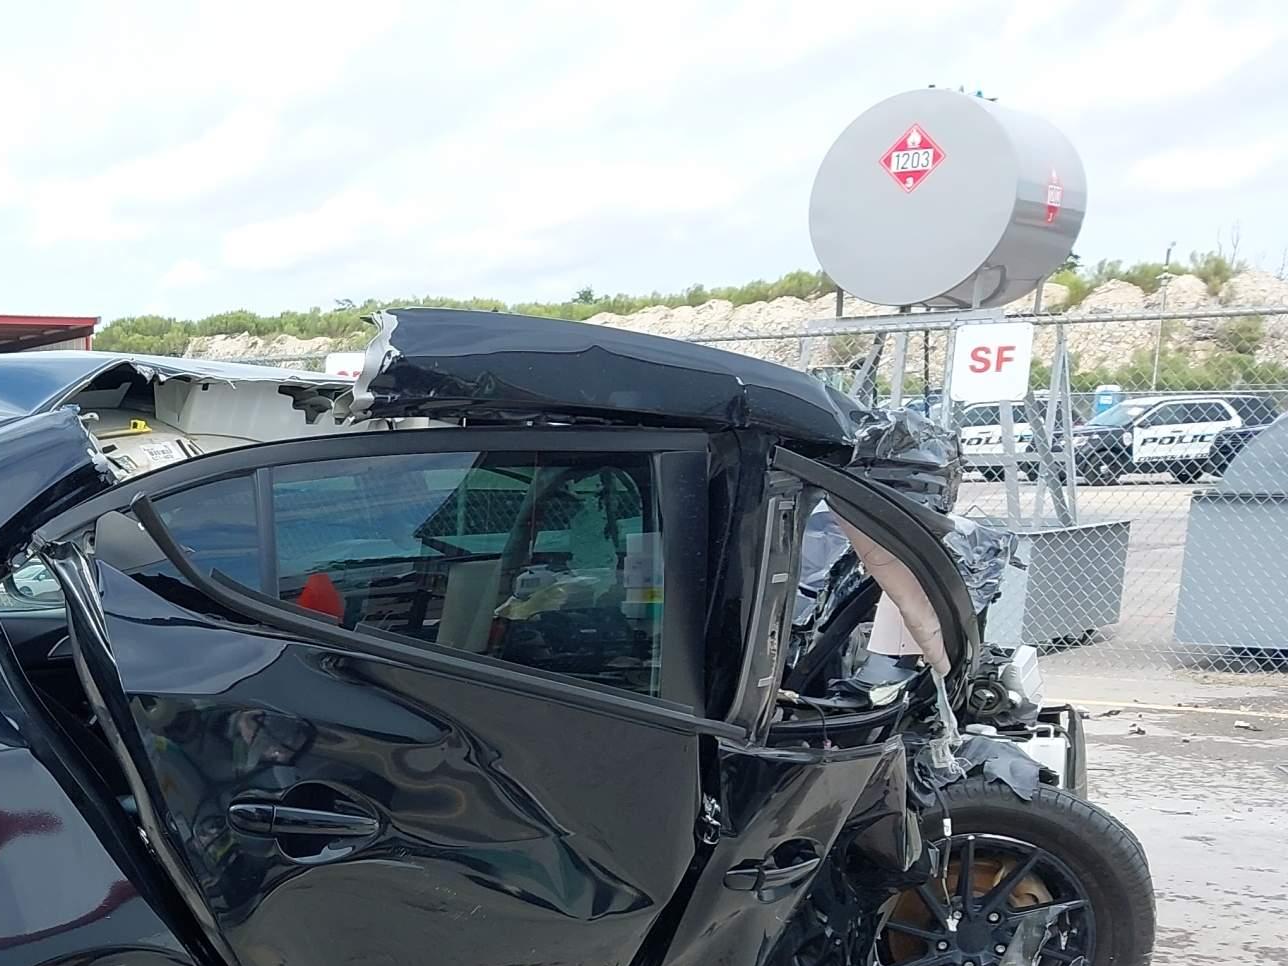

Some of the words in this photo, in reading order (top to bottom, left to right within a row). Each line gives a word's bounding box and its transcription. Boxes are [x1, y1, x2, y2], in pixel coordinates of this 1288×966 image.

[895, 151, 931, 171] 1203
[905, 176, 914, 188] 3
[968, 346, 1016, 373] SF
[1140, 433, 1214, 446] POLIC
